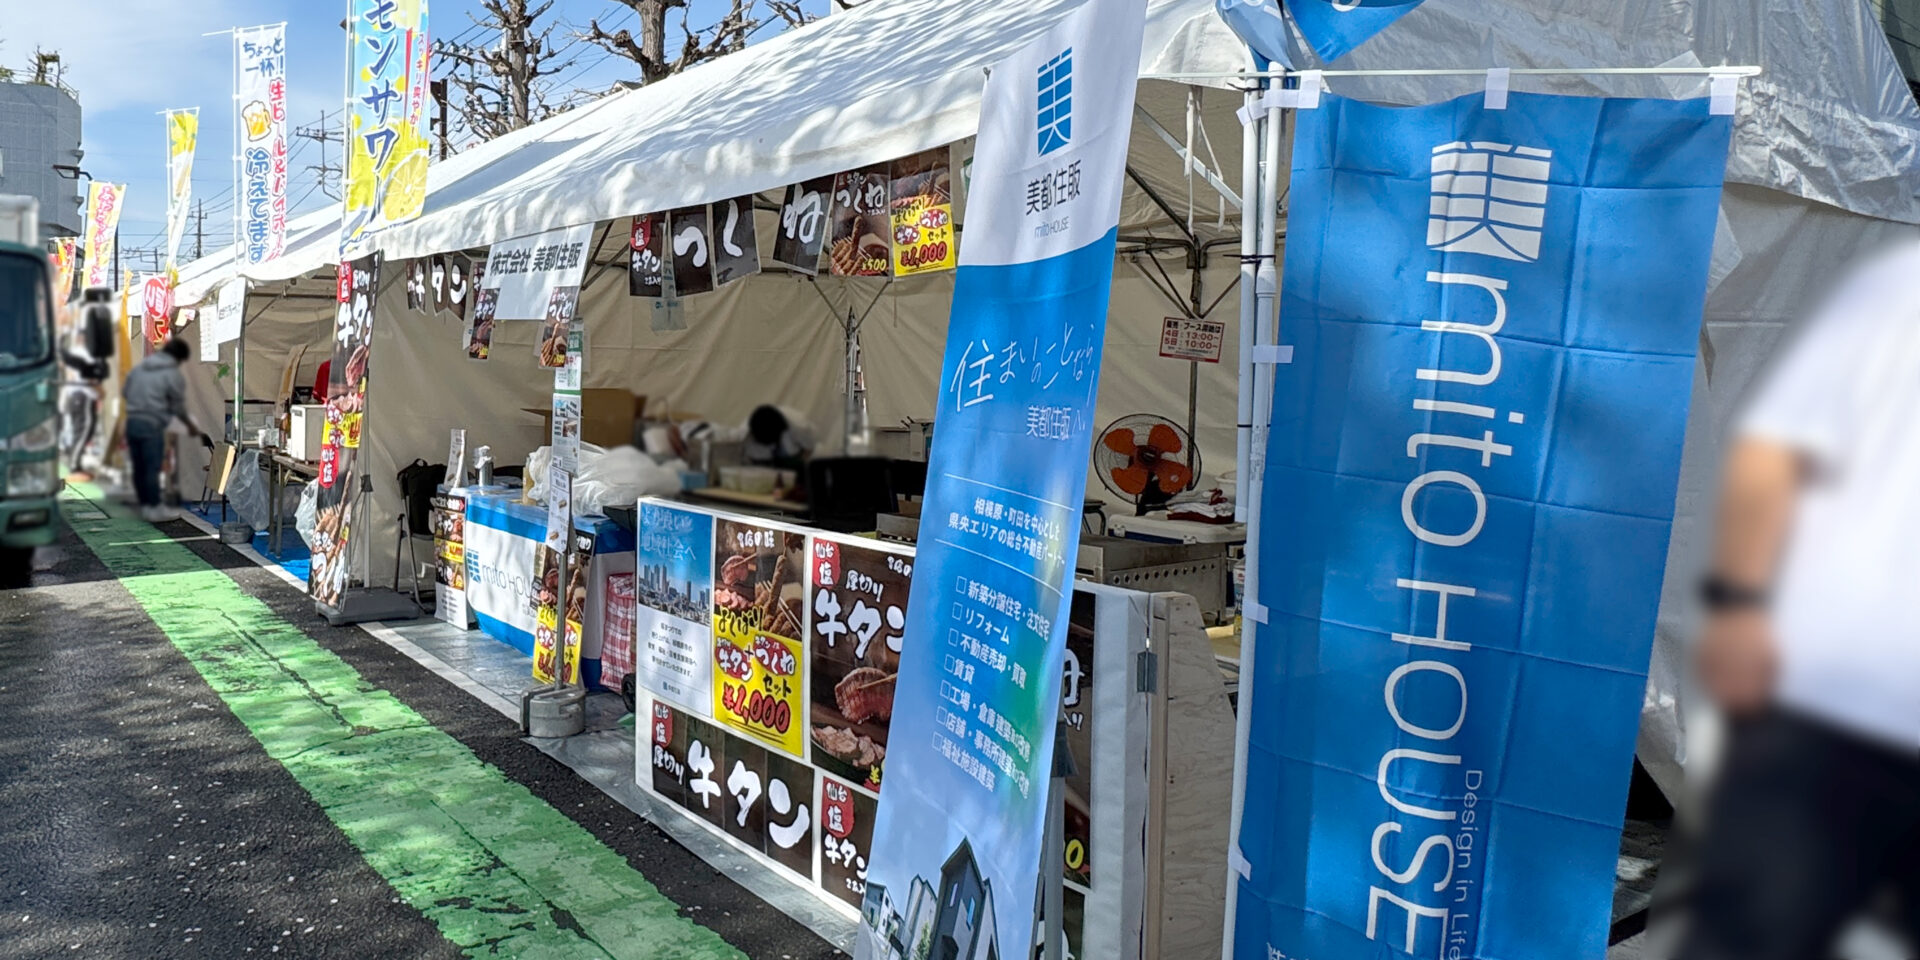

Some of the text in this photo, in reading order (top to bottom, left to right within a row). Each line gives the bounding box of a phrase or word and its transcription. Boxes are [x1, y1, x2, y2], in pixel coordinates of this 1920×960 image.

[243, 37, 284, 59] ちょっと
[245, 147, 271, 263] 冷えてます
[837, 182, 886, 214] つくね
[1026, 160, 1081, 216] 美都住販
[1050, 216, 1069, 235] HOUSE
[490, 242, 583, 276] 株式会社 美都住販
[632, 248, 660, 273] 牛タン
[482, 562, 506, 589] mito
[846, 569, 884, 603] 厚切り
[815, 588, 905, 660] 牛タン
[966, 607, 1010, 645] リフォーム
[1365, 270, 1524, 960] mito HOUSE
[719, 651, 752, 682] 牛タン
[756, 647, 795, 675] つくね
[763, 675, 791, 695] セット
[723, 684, 790, 734] ¥1,000
[653, 745, 684, 786] 厚切り
[687, 739, 810, 849] 牛タン
[826, 782, 848, 803] 仙台
[827, 805, 845, 833] 塩
[825, 834, 867, 879] 牛タン
[1449, 770, 1483, 960] Design in Life
